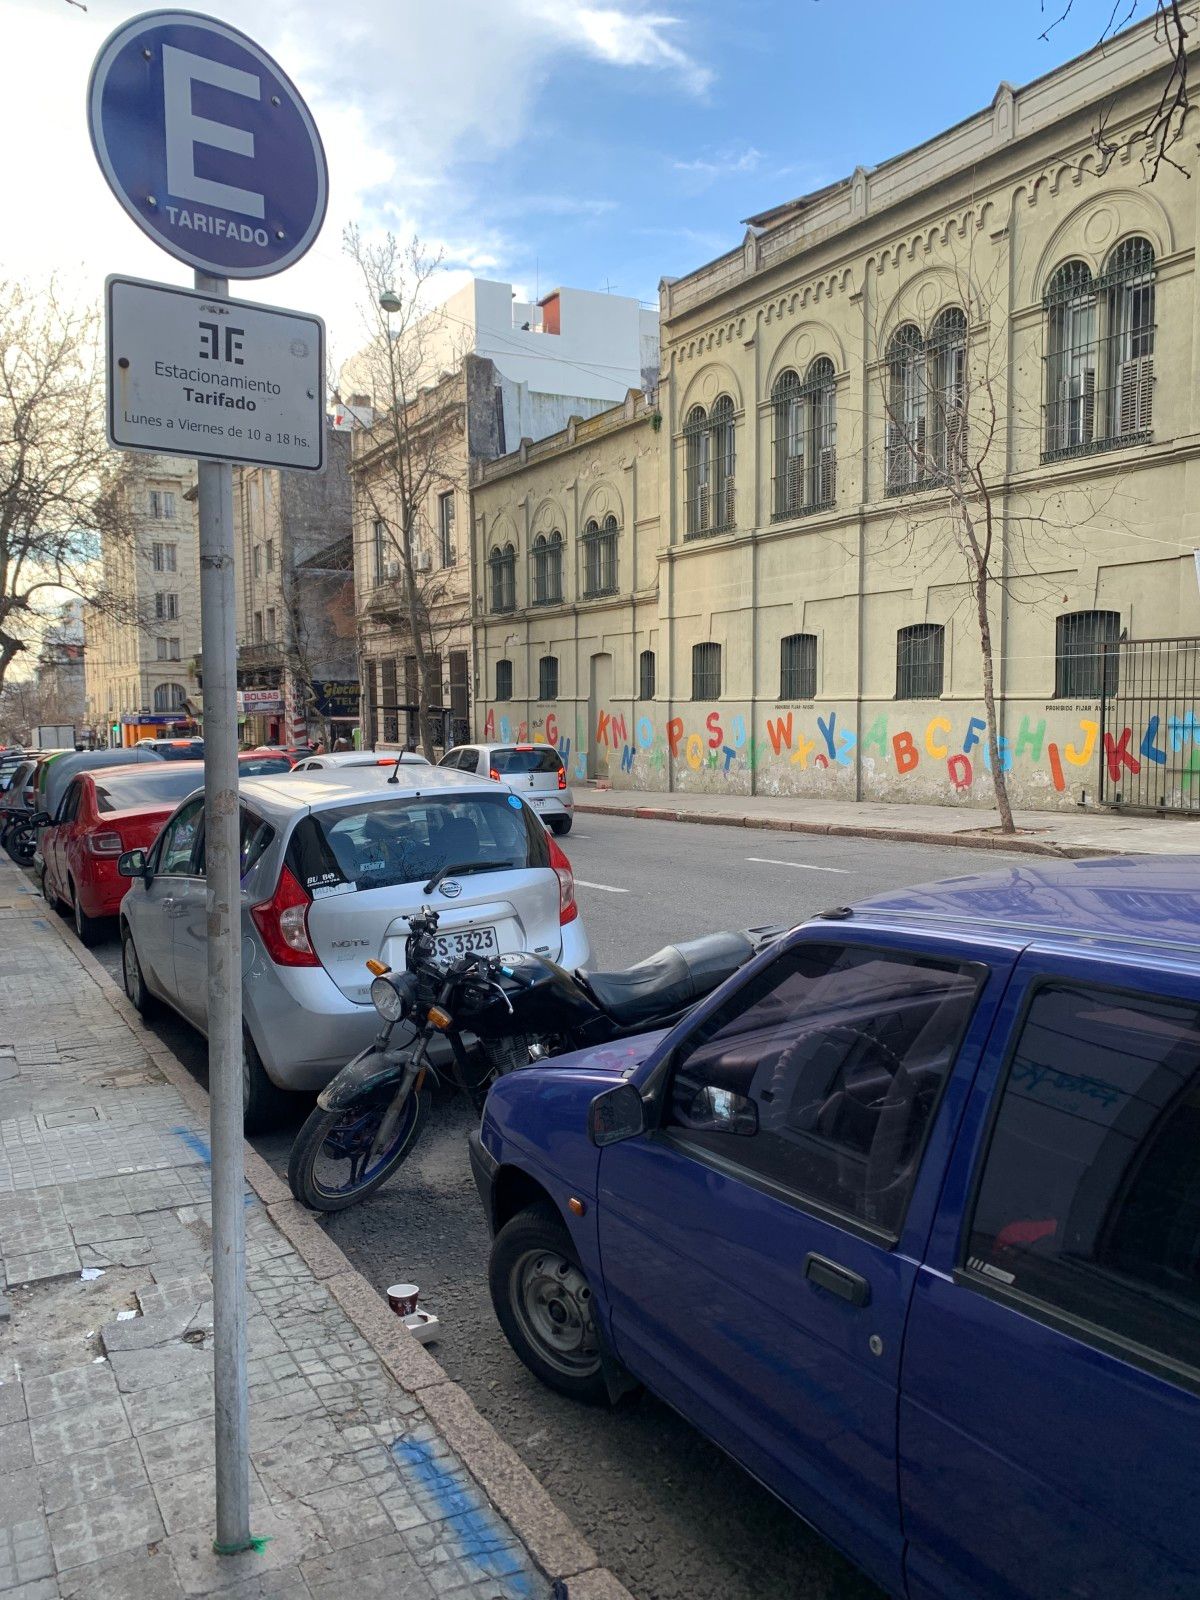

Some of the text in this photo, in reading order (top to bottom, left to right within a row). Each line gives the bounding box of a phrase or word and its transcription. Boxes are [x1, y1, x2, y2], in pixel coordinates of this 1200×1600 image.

[162, 43, 265, 219] E
[165, 204, 269, 247] TARIFADO
[154, 361, 281, 395] Estacionamiento
[182, 387, 257, 412] Tarifado
[124, 411, 310, 448] Lunes a Viernes de 10 a 18 hs.
[244, 691, 279, 701] BOLSAS
[484, 708, 495, 739] A
[546, 713, 558, 746] G
[595, 710, 611, 746] K
[636, 715, 654, 749] O
[666, 717, 684, 758] P
[706, 711, 724, 749] S
[722, 745, 737, 777] T
[766, 711, 793, 756] W
[789, 730, 816, 770] X
[816, 711, 837, 760] Y
[862, 712, 888, 757] A
[892, 730, 919, 774] B
[924, 715, 951, 760] C
[963, 716, 987, 753] F
[1014, 714, 1047, 763] H
[1047, 742, 1066, 793] I
[1063, 719, 1099, 767] J
[1104, 727, 1141, 782] K
[1139, 714, 1167, 765] L
[331, 938, 370, 949] NOTE
[453, 930, 493, 954] 3323
